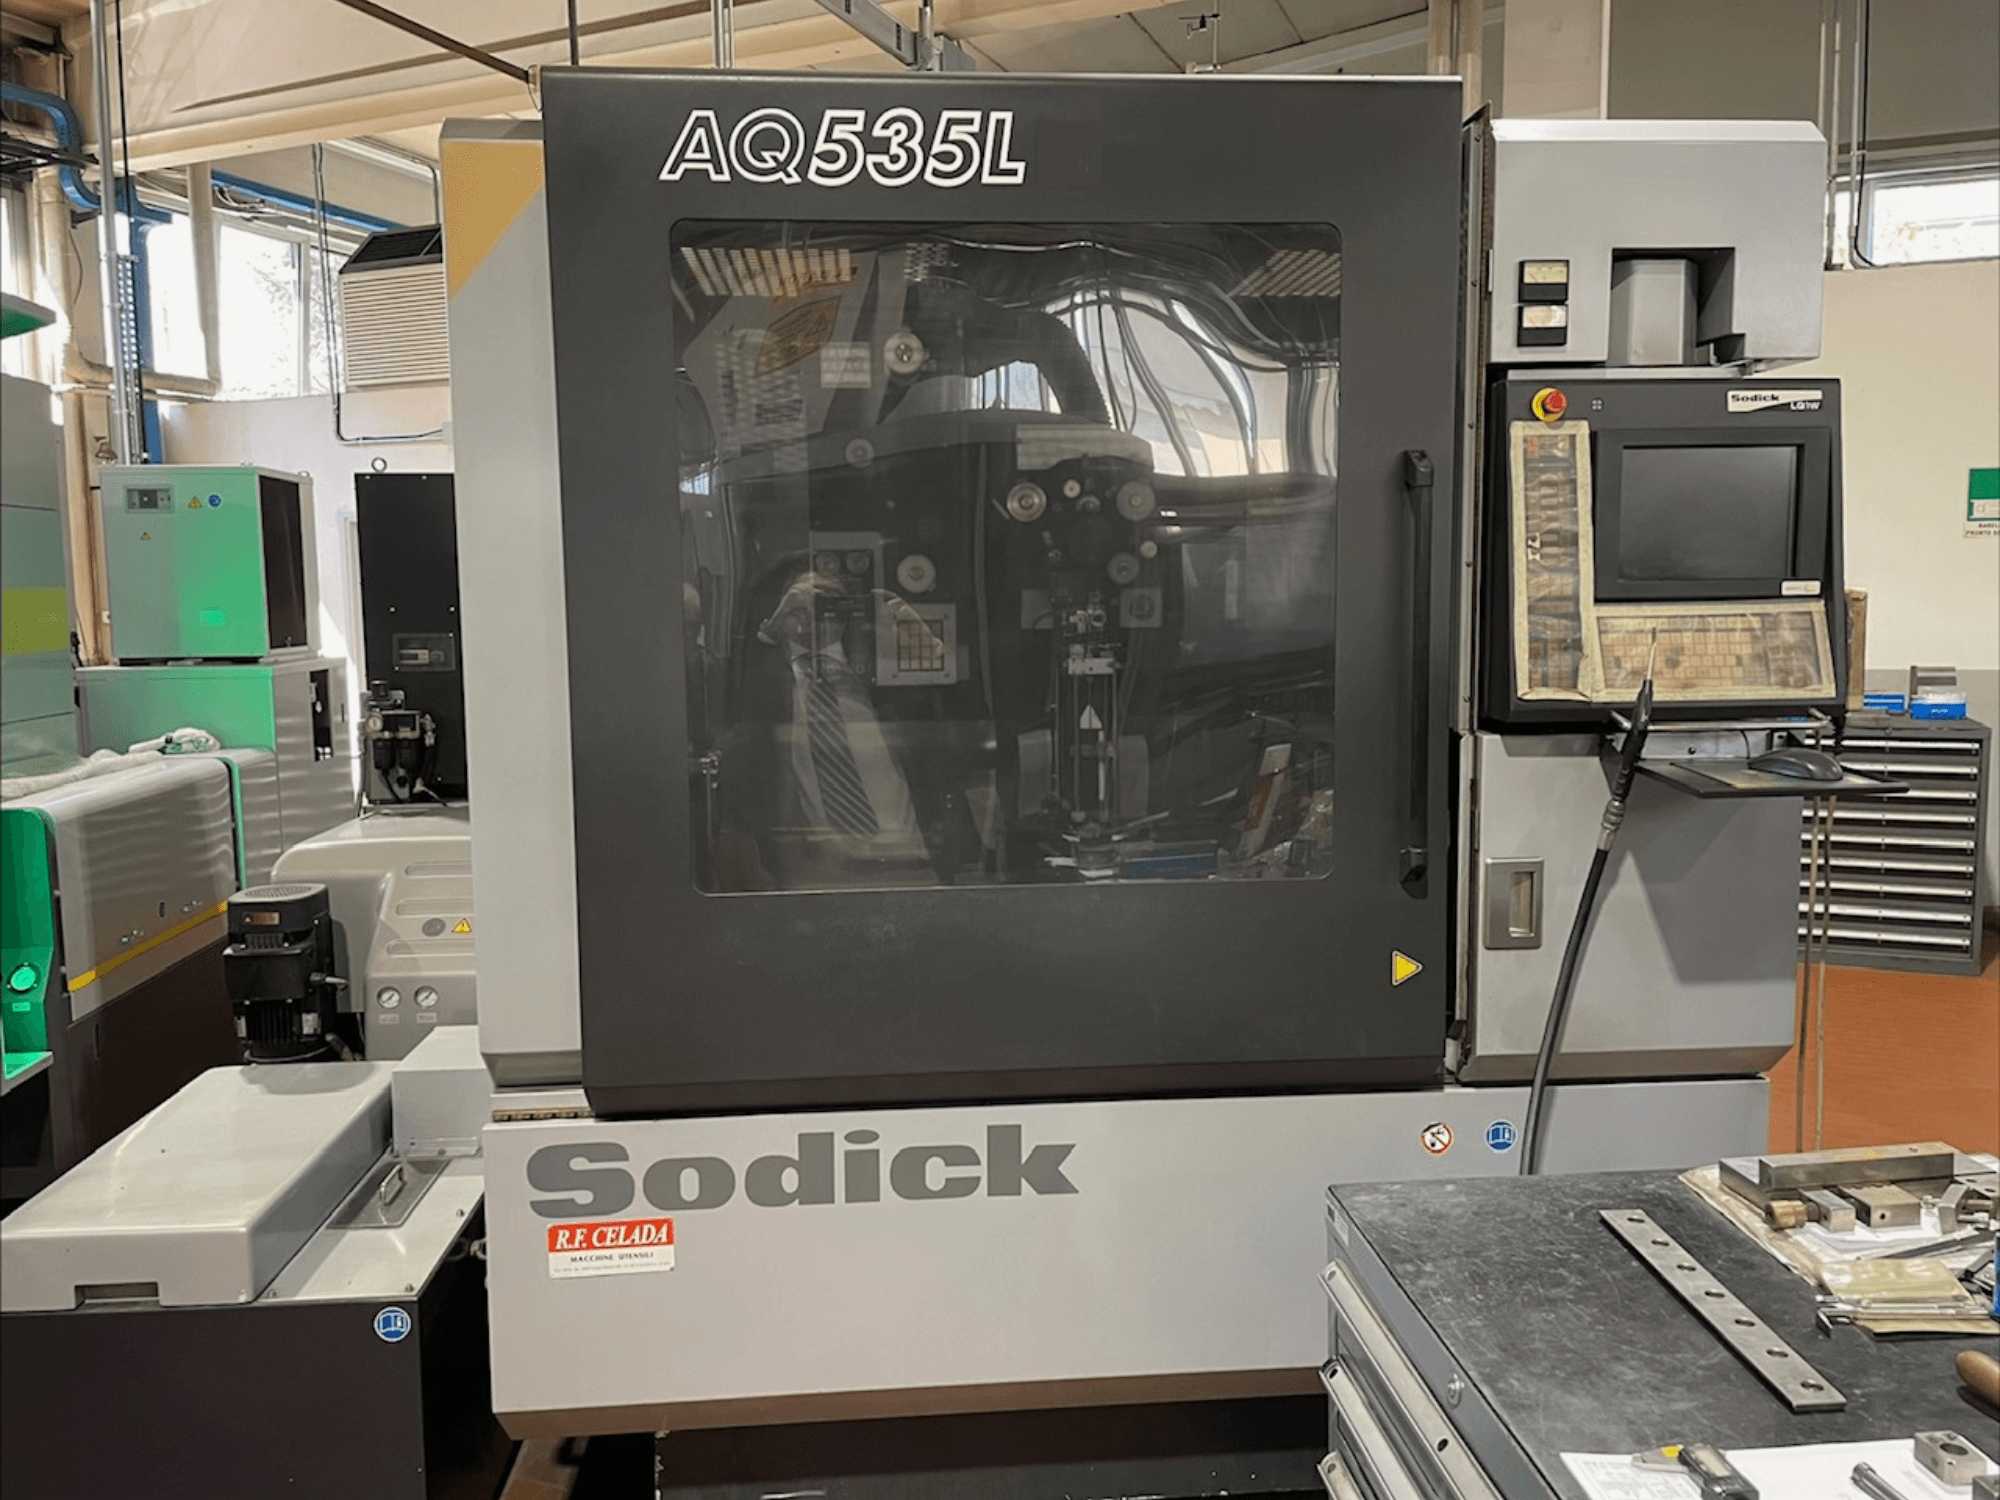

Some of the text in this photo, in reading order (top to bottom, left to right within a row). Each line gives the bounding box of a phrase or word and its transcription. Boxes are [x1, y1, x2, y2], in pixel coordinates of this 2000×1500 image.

[658, 107, 1026, 187] AQ535L
[1731, 394, 1779, 402] Sodick
[526, 1124, 1079, 1219] Sodick
[555, 1223, 668, 1250] R.F. CELADA
[570, 1253, 613, 1262] MACCHINE
